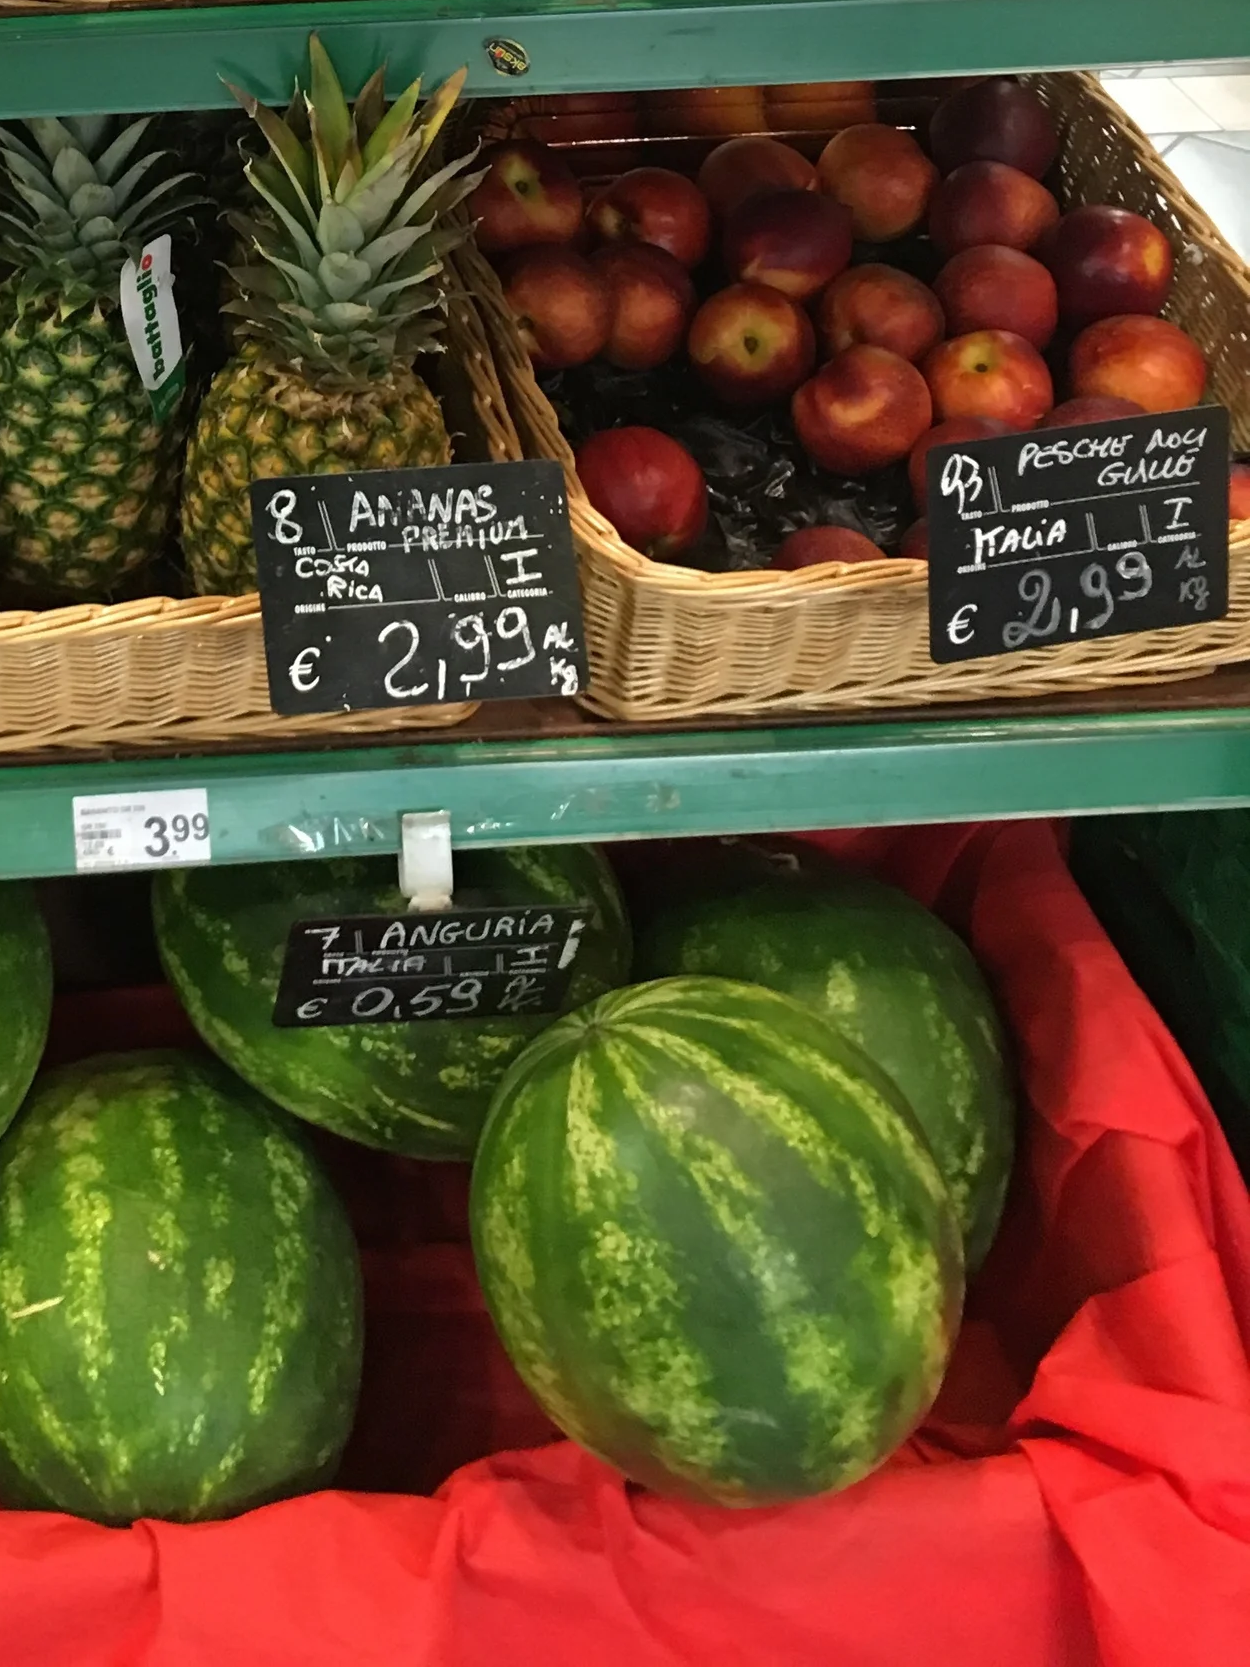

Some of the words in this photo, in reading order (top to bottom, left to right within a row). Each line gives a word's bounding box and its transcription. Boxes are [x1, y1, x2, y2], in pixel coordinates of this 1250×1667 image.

[136, 254, 166, 382] battaglio
[1018, 434, 1133, 477] PESCHE
[265, 489, 303, 545] 8
[349, 485, 497, 532] ANANAS
[1163, 497, 1192, 529] I
[346, 541, 387, 552] PRODOTTO
[402, 515, 528, 553] PREMIUM
[500, 548, 543, 585] I
[507, 587, 548, 599] CATEGORIA
[946, 604, 978, 645] €
[288, 647, 321, 692] €
[378, 606, 536, 700] 2,99
[144, 813, 210, 857] 3.99
[304, 926, 340, 950] 7
[379, 909, 554, 949] ANGURIA
[297, 997, 328, 1020] €
